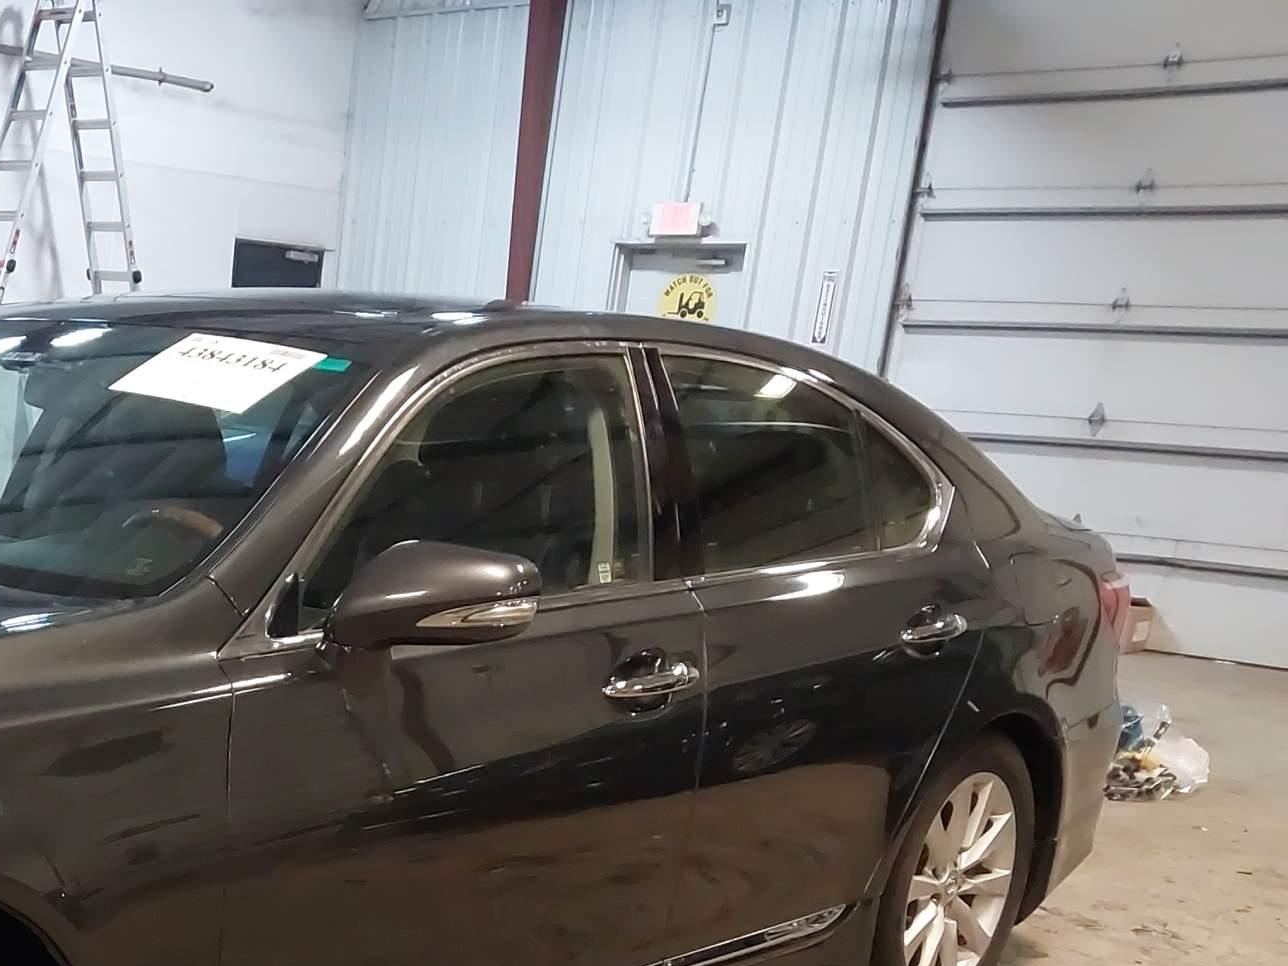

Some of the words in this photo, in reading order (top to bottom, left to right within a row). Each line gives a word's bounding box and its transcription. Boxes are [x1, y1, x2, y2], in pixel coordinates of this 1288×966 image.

[664, 276, 687, 296] WATCH
[689, 275, 703, 285] OUT
[702, 282, 713, 298] FOR
[178, 347, 288, 372] 43843184
